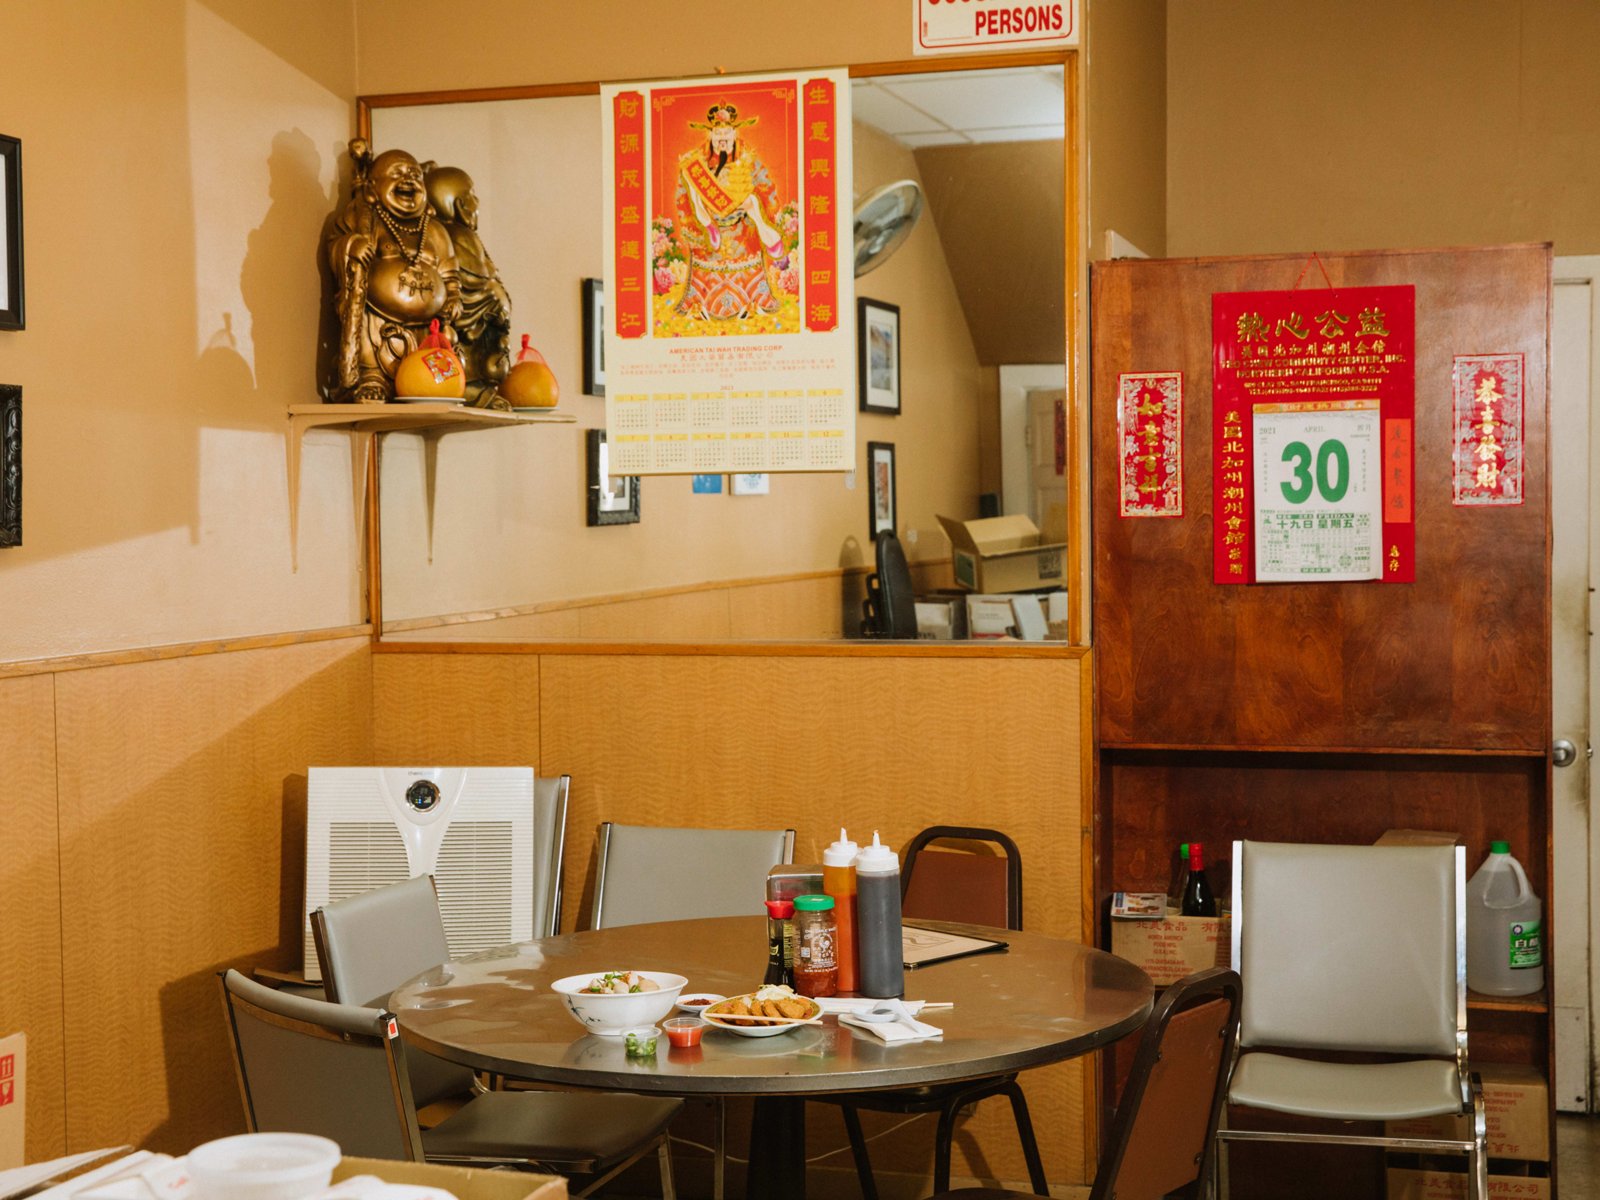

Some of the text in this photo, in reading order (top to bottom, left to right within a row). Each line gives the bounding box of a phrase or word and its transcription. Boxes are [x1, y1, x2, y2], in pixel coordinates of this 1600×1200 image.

[975, 4, 1063, 36] PERSONS
[619, 98, 641, 329] 財源茂盛達三江
[808, 85, 833, 323] 生意興隆通四海
[1236, 365, 1390, 379] NORTHERN CALIFORNIA U.S.A.
[1275, 357, 1336, 367] COMMUNITY
[1338, 355, 1383, 364] CENTER,
[1385, 354, 1406, 363] INC.
[1259, 427, 1276, 435] 2021
[1474, 376, 1503, 489] 恭喜發財
[1280, 438, 1350, 504] 30
[1277, 519, 1354, 529] 十九日 星期五
[1201, 921, 1231, 933] 有限
